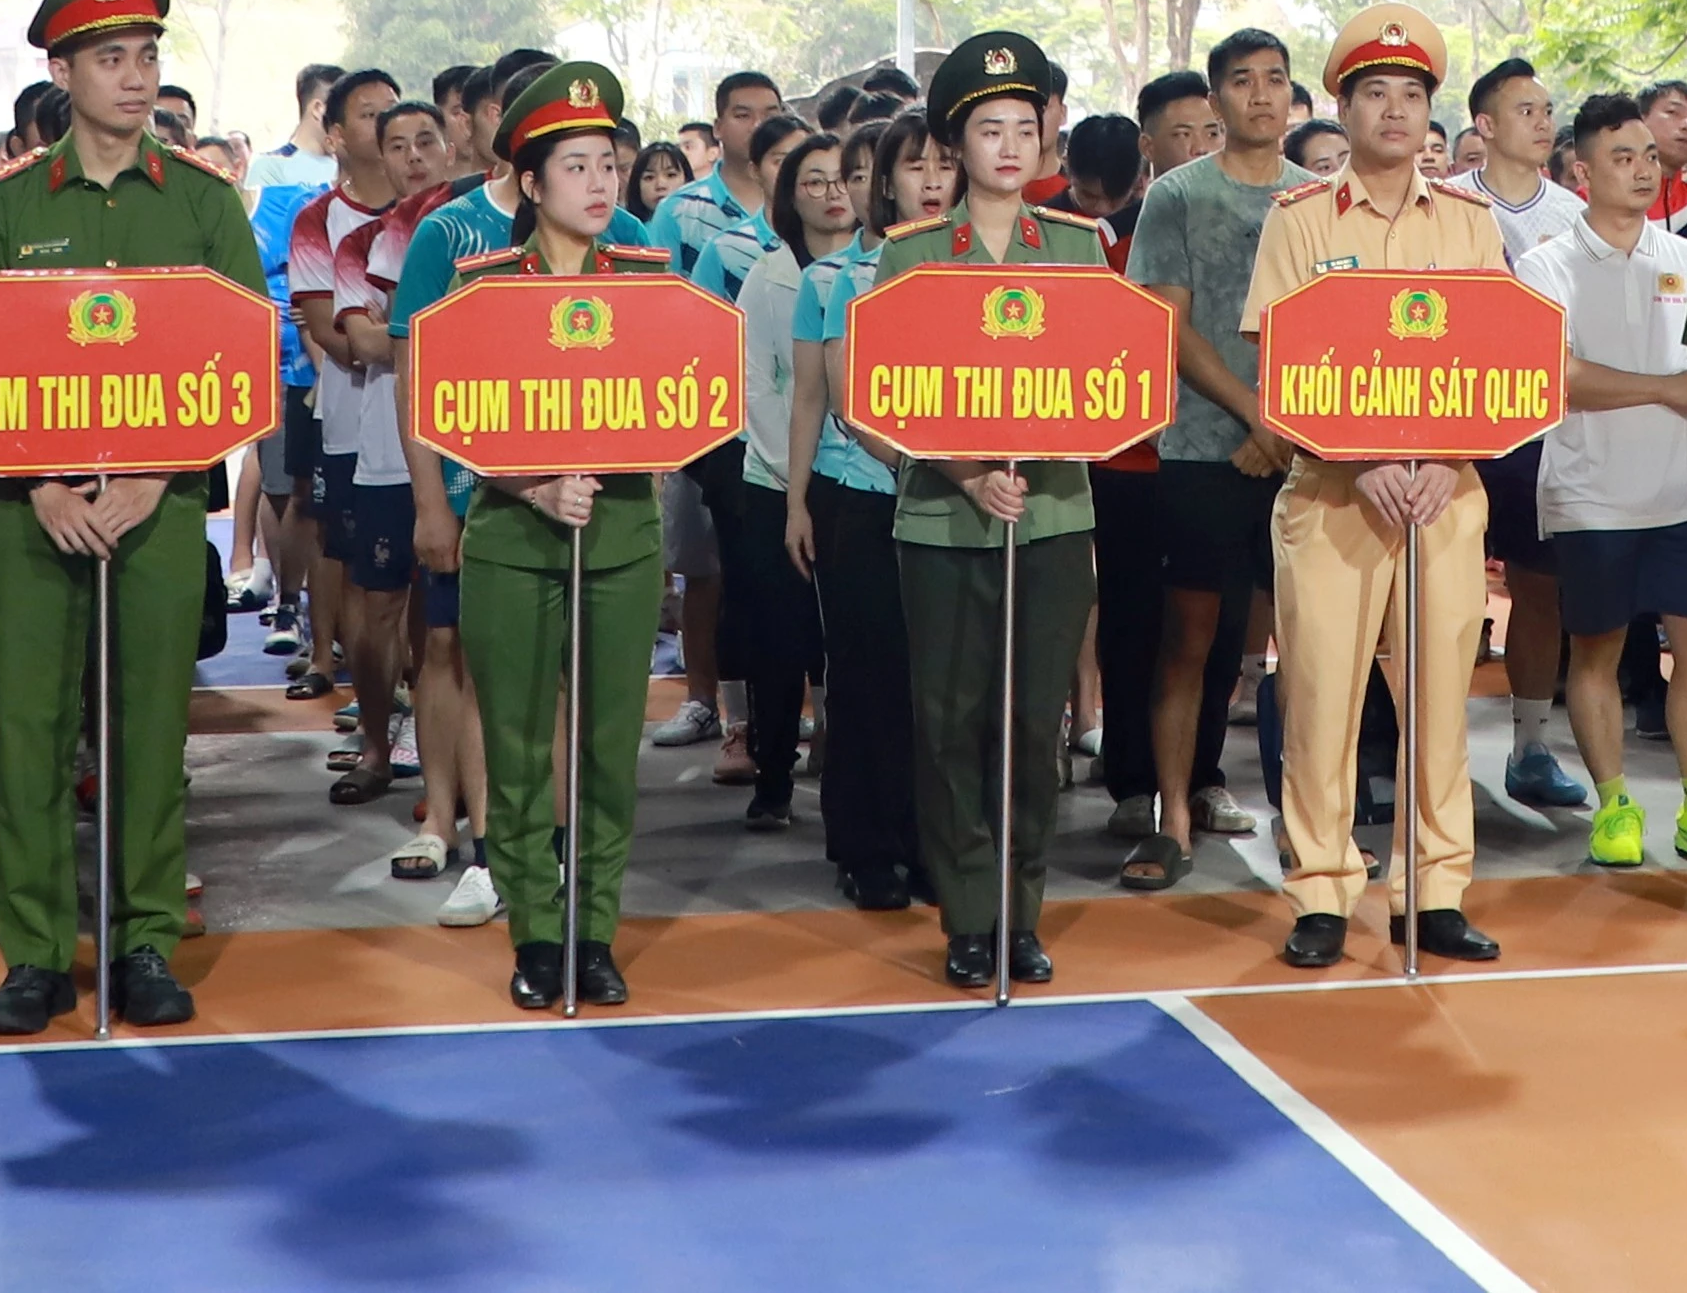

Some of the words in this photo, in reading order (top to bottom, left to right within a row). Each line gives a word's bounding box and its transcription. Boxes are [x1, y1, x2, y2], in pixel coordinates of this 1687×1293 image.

[37, 375, 91, 429] THI
[100, 373, 167, 429] ĐUA
[177, 352, 223, 427] SỐ
[231, 373, 252, 426] 3
[433, 379, 510, 445] CỤM
[519, 378, 572, 432] THI
[581, 377, 647, 431] ĐUA
[655, 357, 701, 429] SỐ
[708, 376, 729, 428] 2
[869, 364, 944, 429] CỤM
[953, 366, 1003, 418] THI
[1011, 367, 1075, 419] ĐUA
[1084, 350, 1129, 420] SỐ
[1137, 370, 1152, 420] 1
[1280, 345, 1343, 416] KHỐI
[1349, 348, 1422, 418] CẢNH
[1428, 356, 1479, 418] SÁT
[1484, 368, 1549, 424] QLHC
